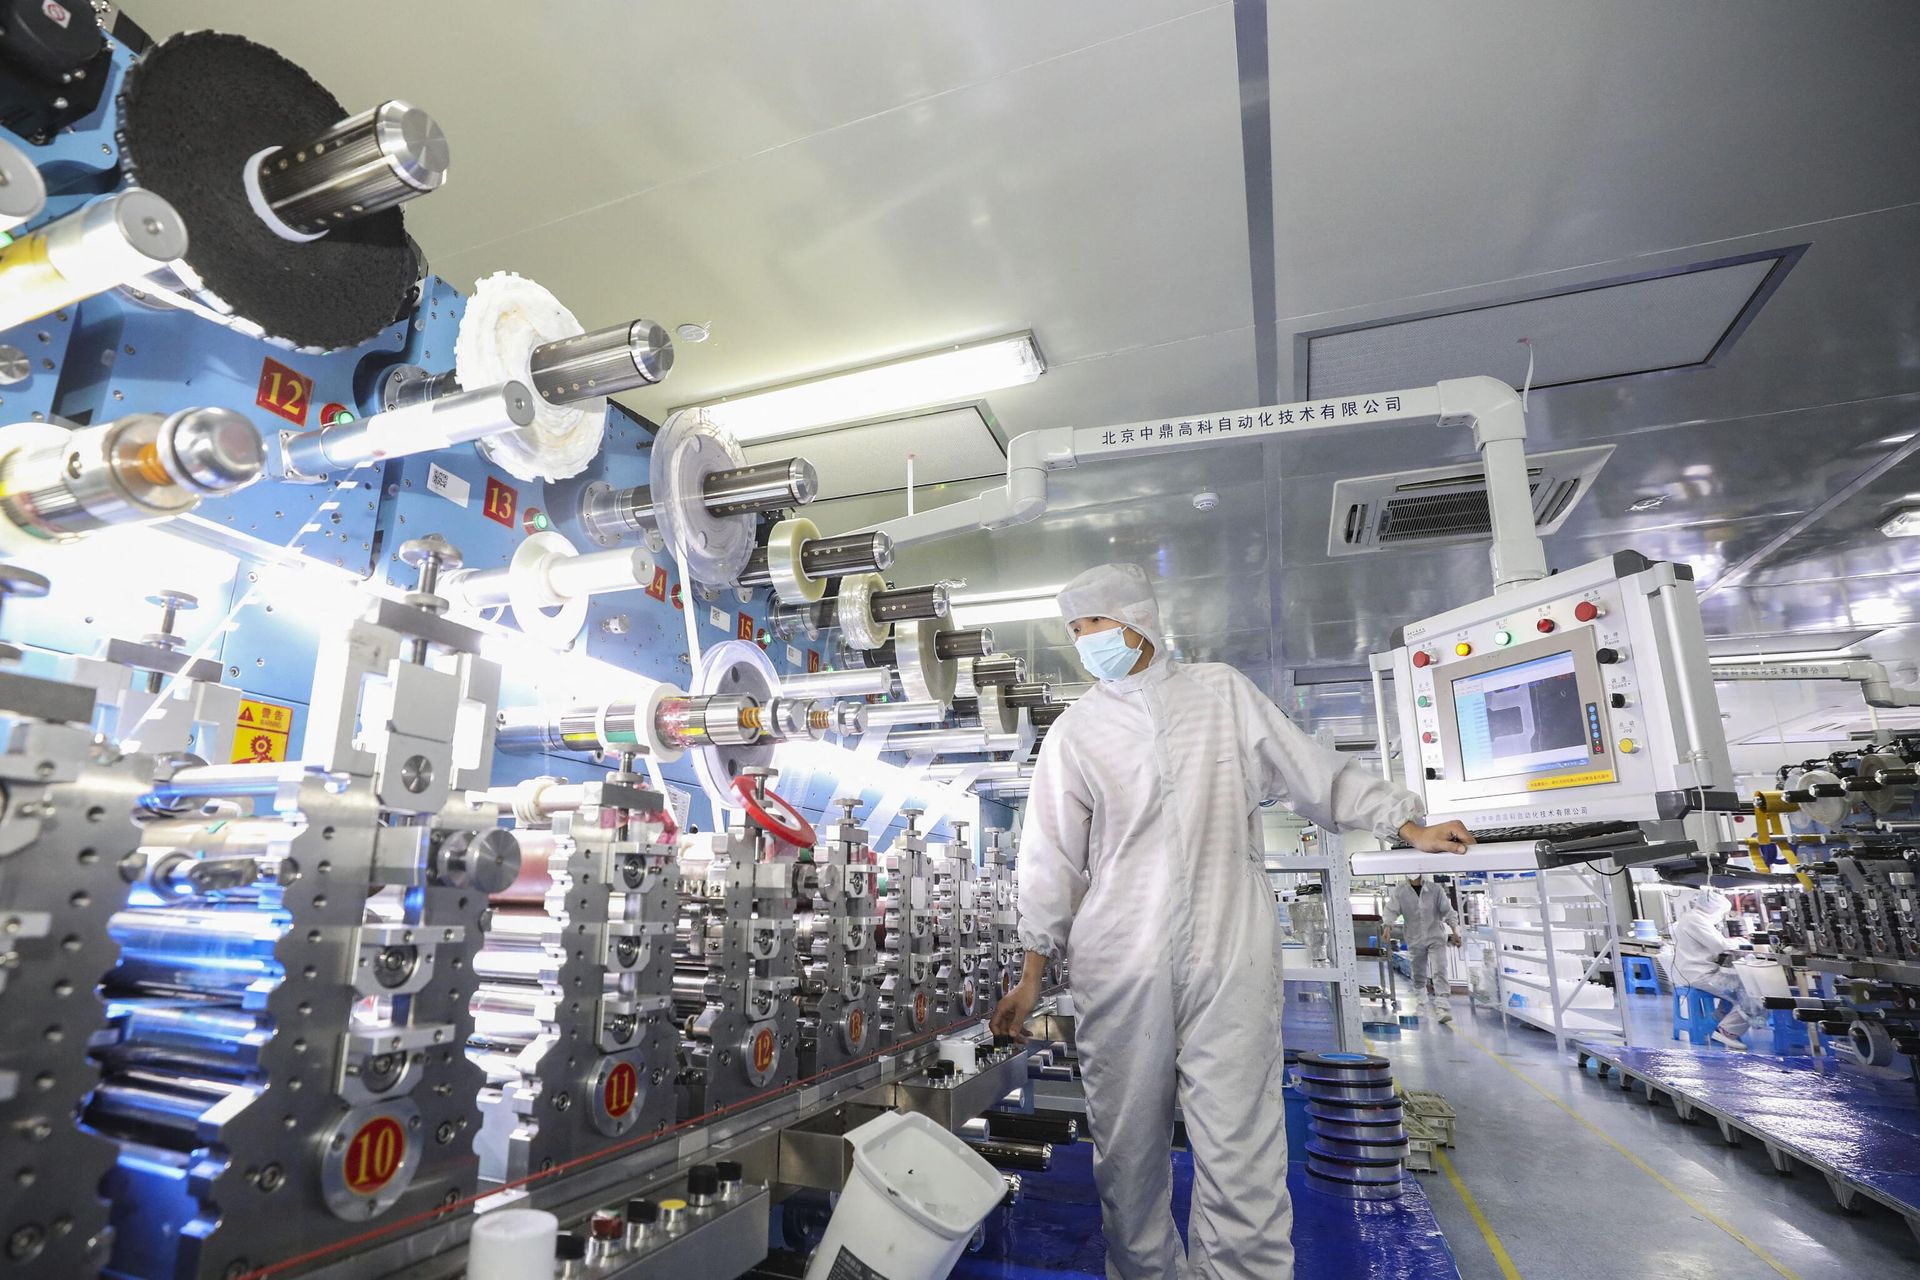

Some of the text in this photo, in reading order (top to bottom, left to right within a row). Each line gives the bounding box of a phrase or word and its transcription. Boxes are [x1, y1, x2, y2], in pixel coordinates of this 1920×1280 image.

[265, 372, 303, 416] 12
[1102, 396, 1401, 445] 北京中鼎高科自动化技术有限公司
[489, 487, 512, 519] 13
[740, 617, 752, 640] 15
[809, 653, 818, 673] 16
[757, 1038, 770, 1067] 12
[608, 1071, 629, 1110] 11
[355, 1127, 395, 1185] 10
